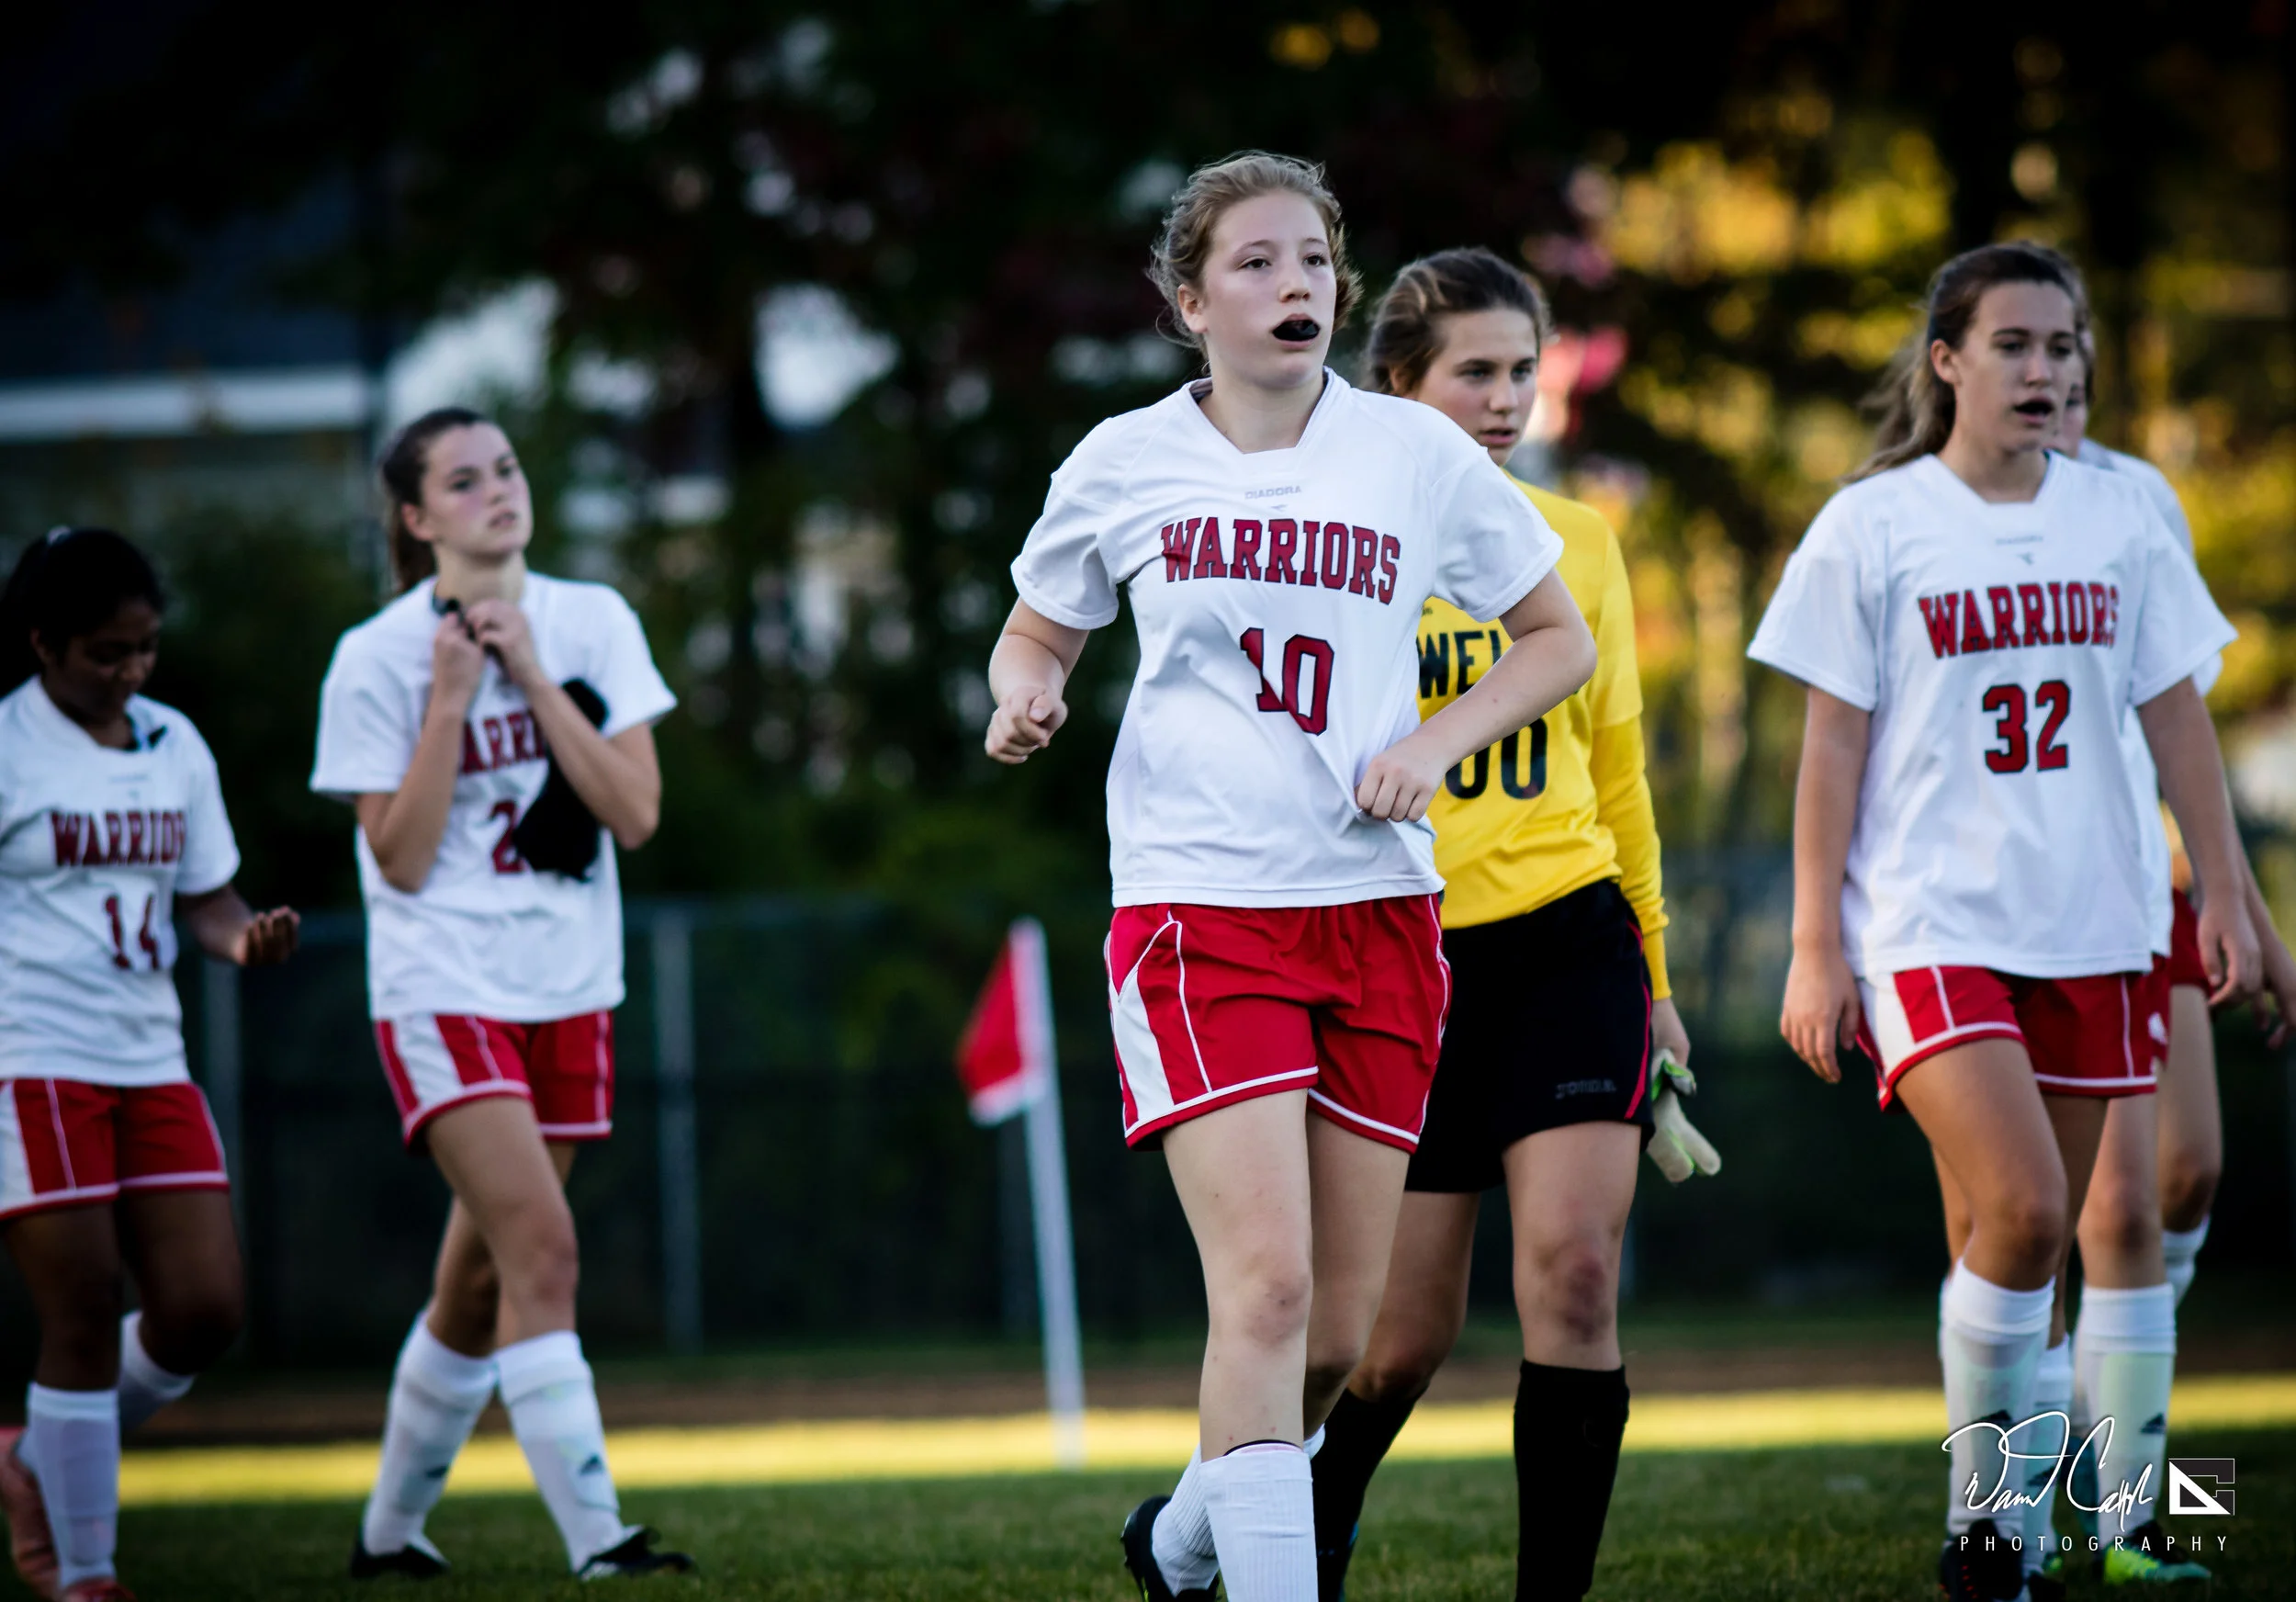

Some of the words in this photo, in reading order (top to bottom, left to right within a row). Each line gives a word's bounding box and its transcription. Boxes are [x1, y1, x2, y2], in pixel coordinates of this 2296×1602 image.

[1244, 485, 1301, 500] DIADORA
[1160, 516, 1401, 606] WARRIORS
[1239, 626, 1335, 737] 10
[1982, 679, 2073, 774] 32
